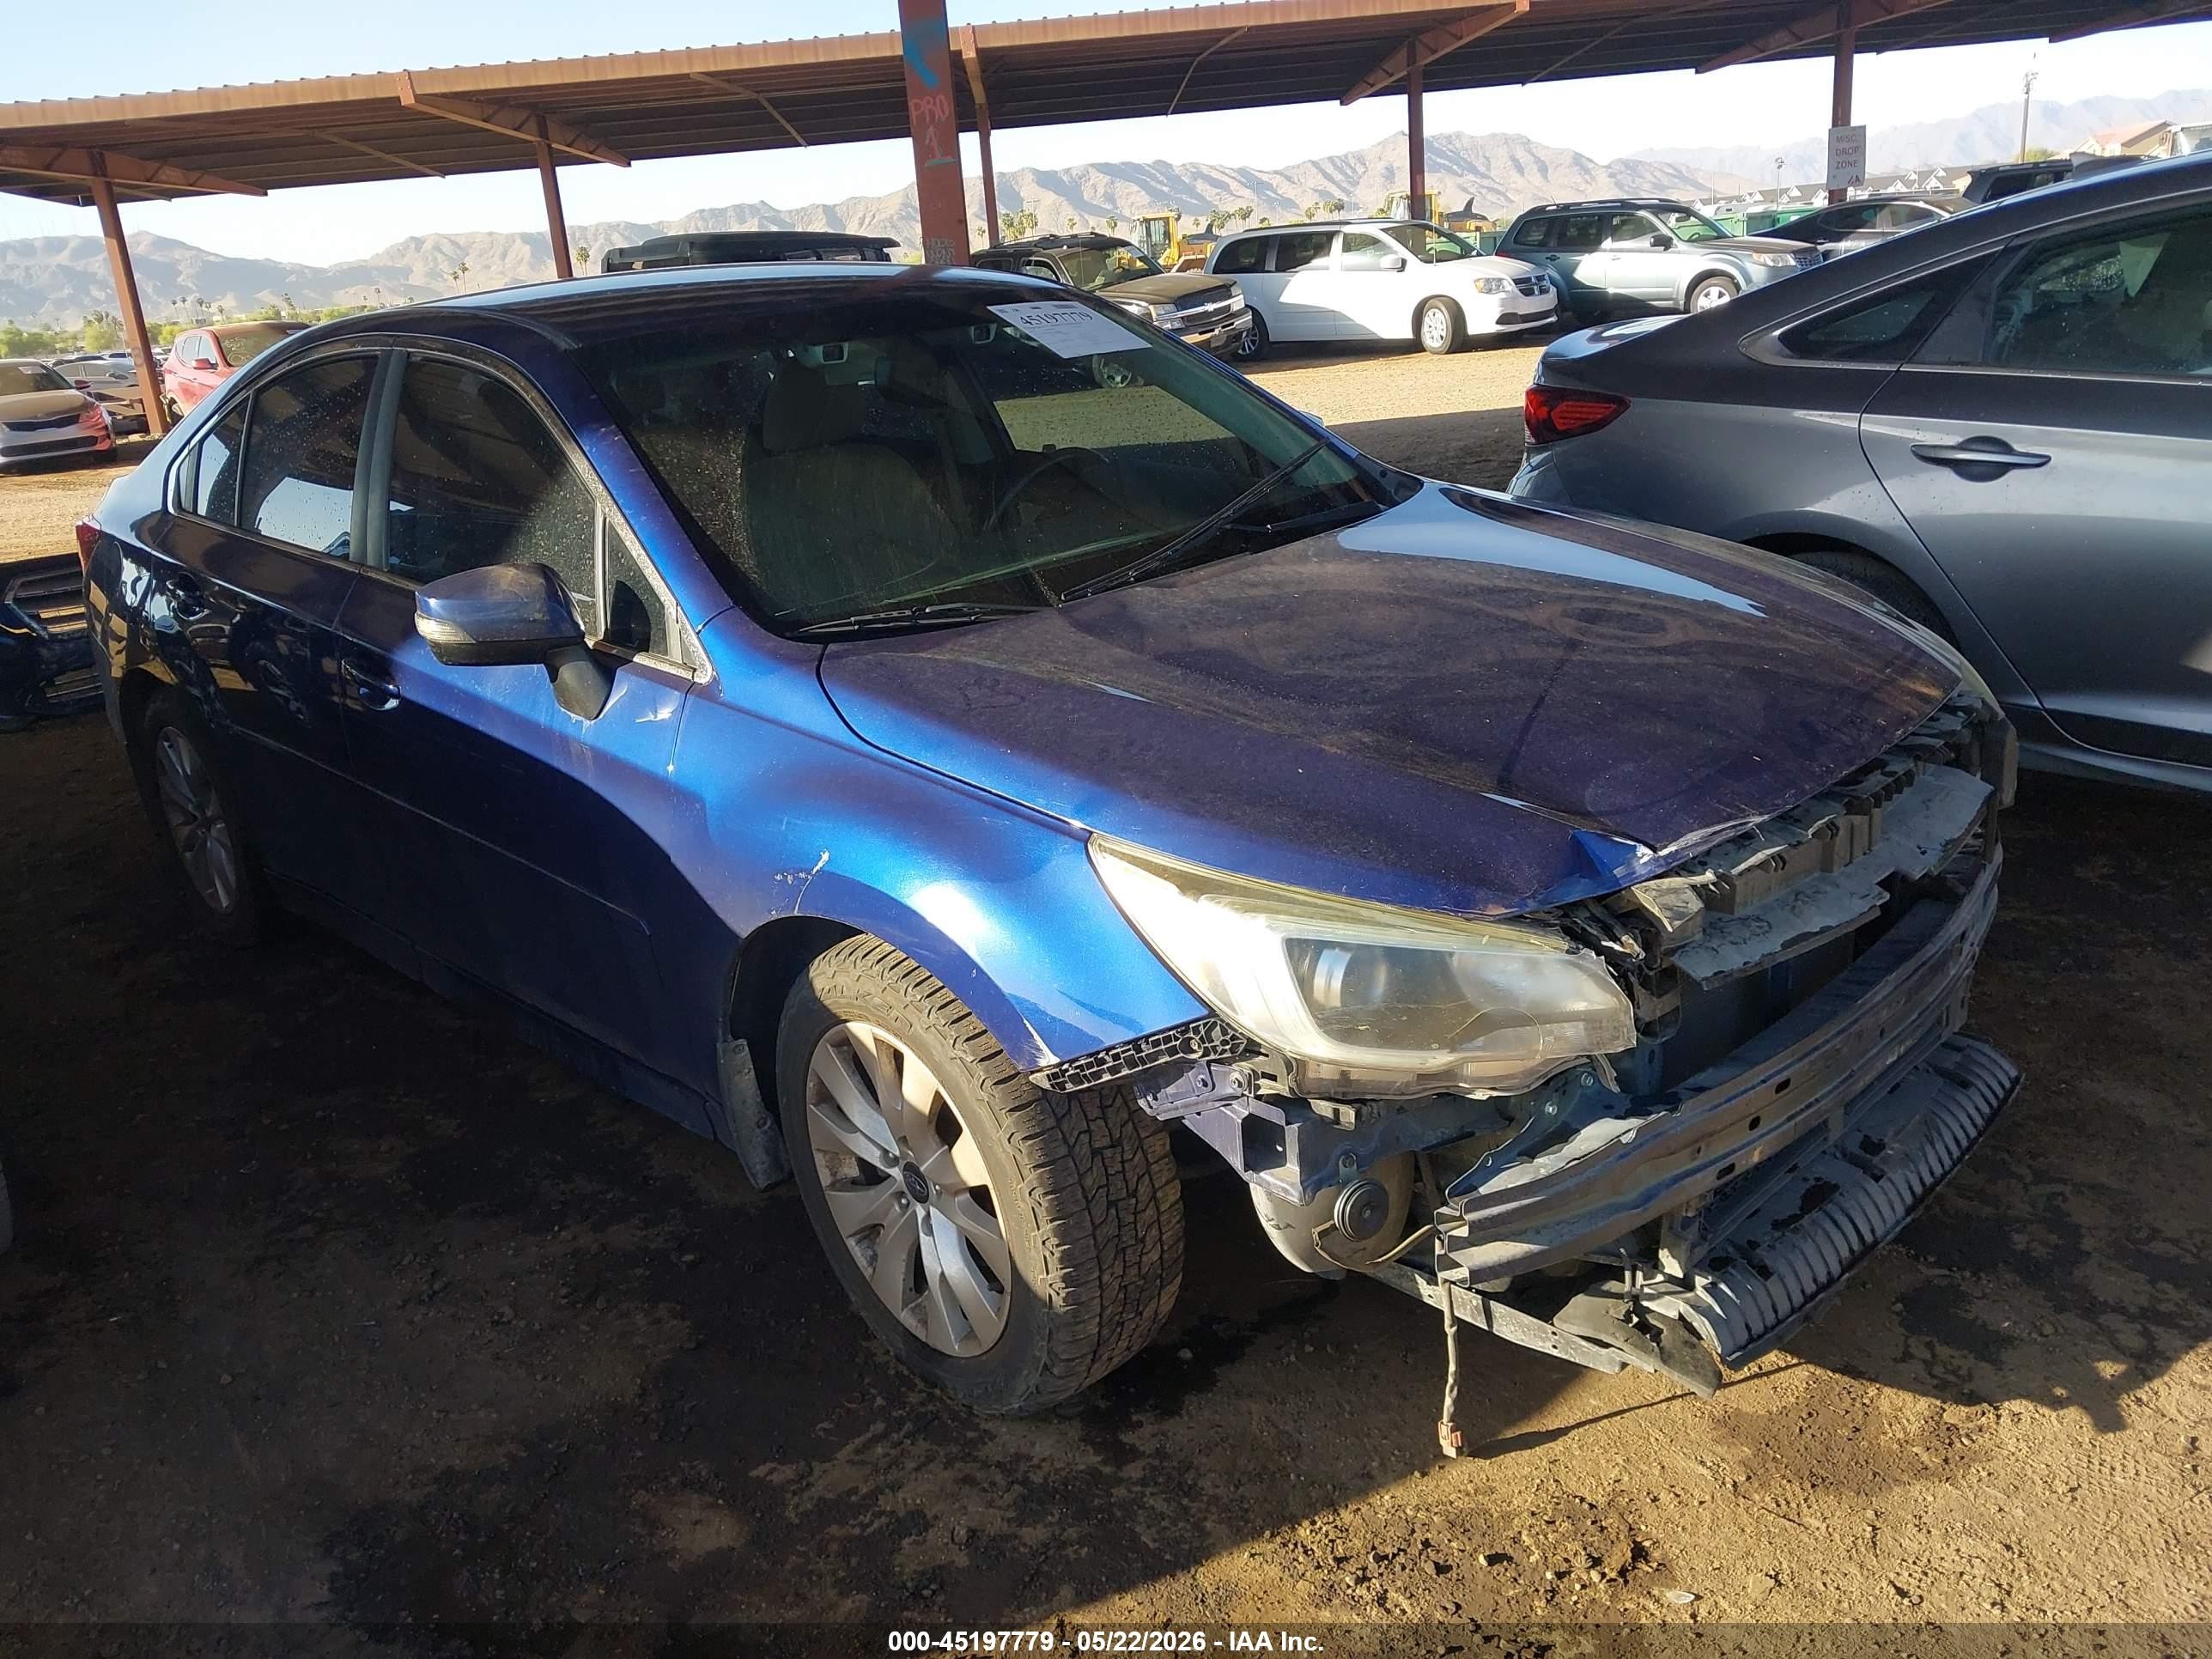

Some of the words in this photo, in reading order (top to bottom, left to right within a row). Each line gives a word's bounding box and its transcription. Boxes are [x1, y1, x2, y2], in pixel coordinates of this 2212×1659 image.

[1836, 133, 1856, 143] MISC
[1835, 145, 1860, 156] DROP
[1835, 159, 1860, 170] ZONE
[1019, 311, 1093, 326] 45197779
